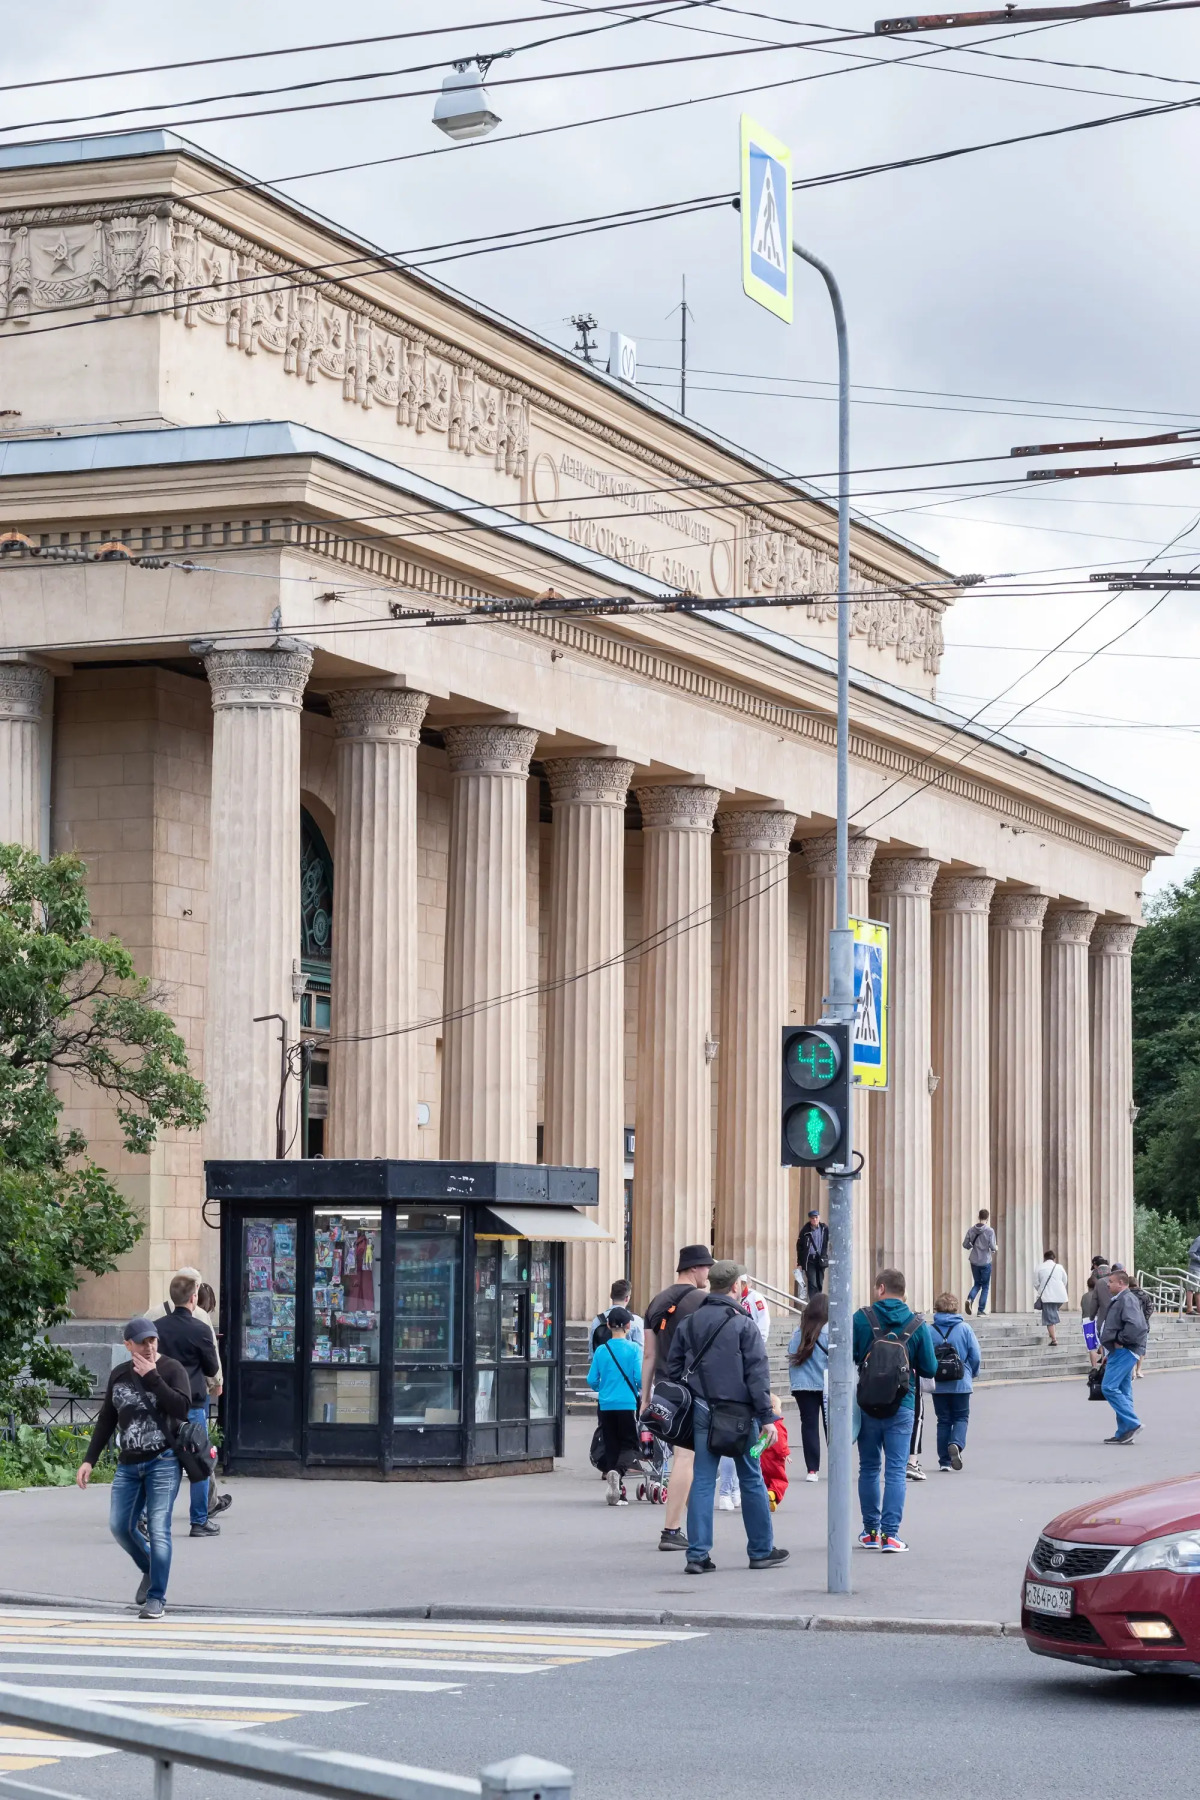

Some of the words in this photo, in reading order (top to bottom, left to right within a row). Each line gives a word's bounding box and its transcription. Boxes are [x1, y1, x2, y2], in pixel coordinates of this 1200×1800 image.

[568, 511, 655, 575] КИРОВСКИЙ
[662, 555, 702, 594] ЗАВОД
[798, 1043, 834, 1079] 43
